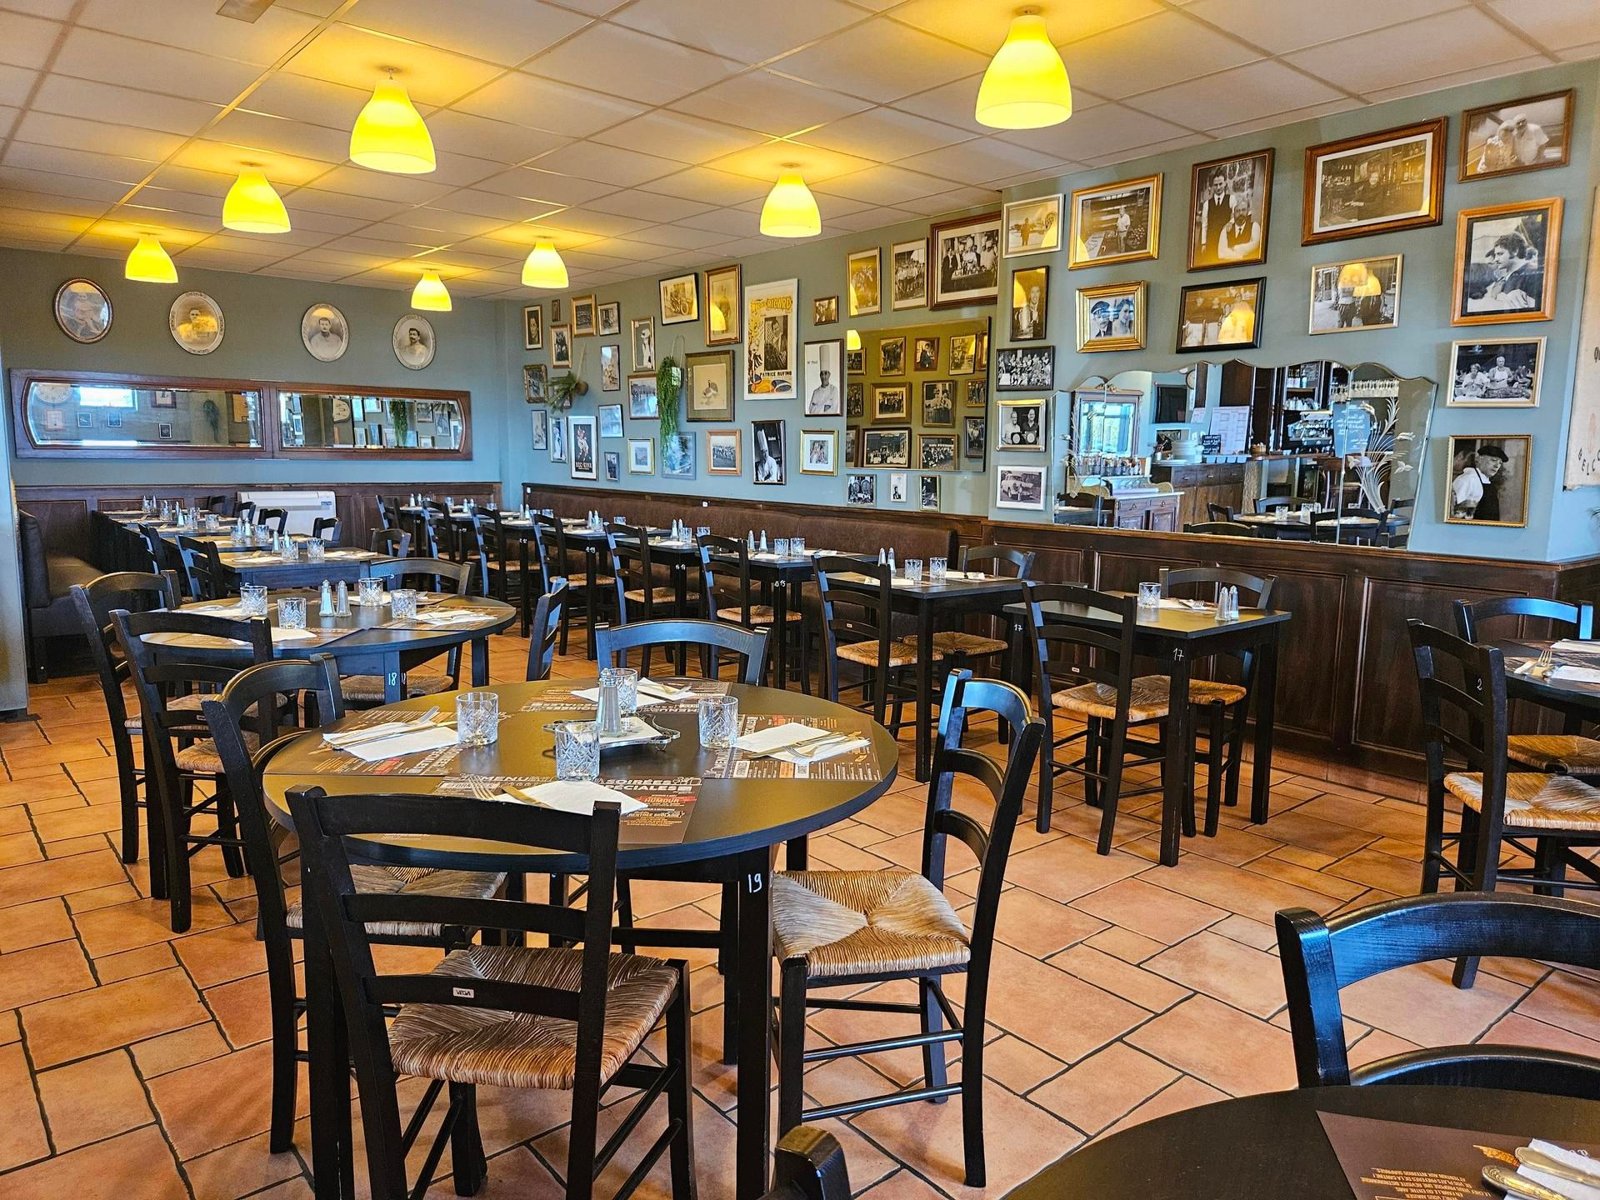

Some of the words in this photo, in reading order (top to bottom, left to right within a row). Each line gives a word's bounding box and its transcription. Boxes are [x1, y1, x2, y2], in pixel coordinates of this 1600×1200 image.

[1172, 648, 1184, 662] 17
[388, 672, 397, 686] 18
[748, 873, 762, 894] 19
